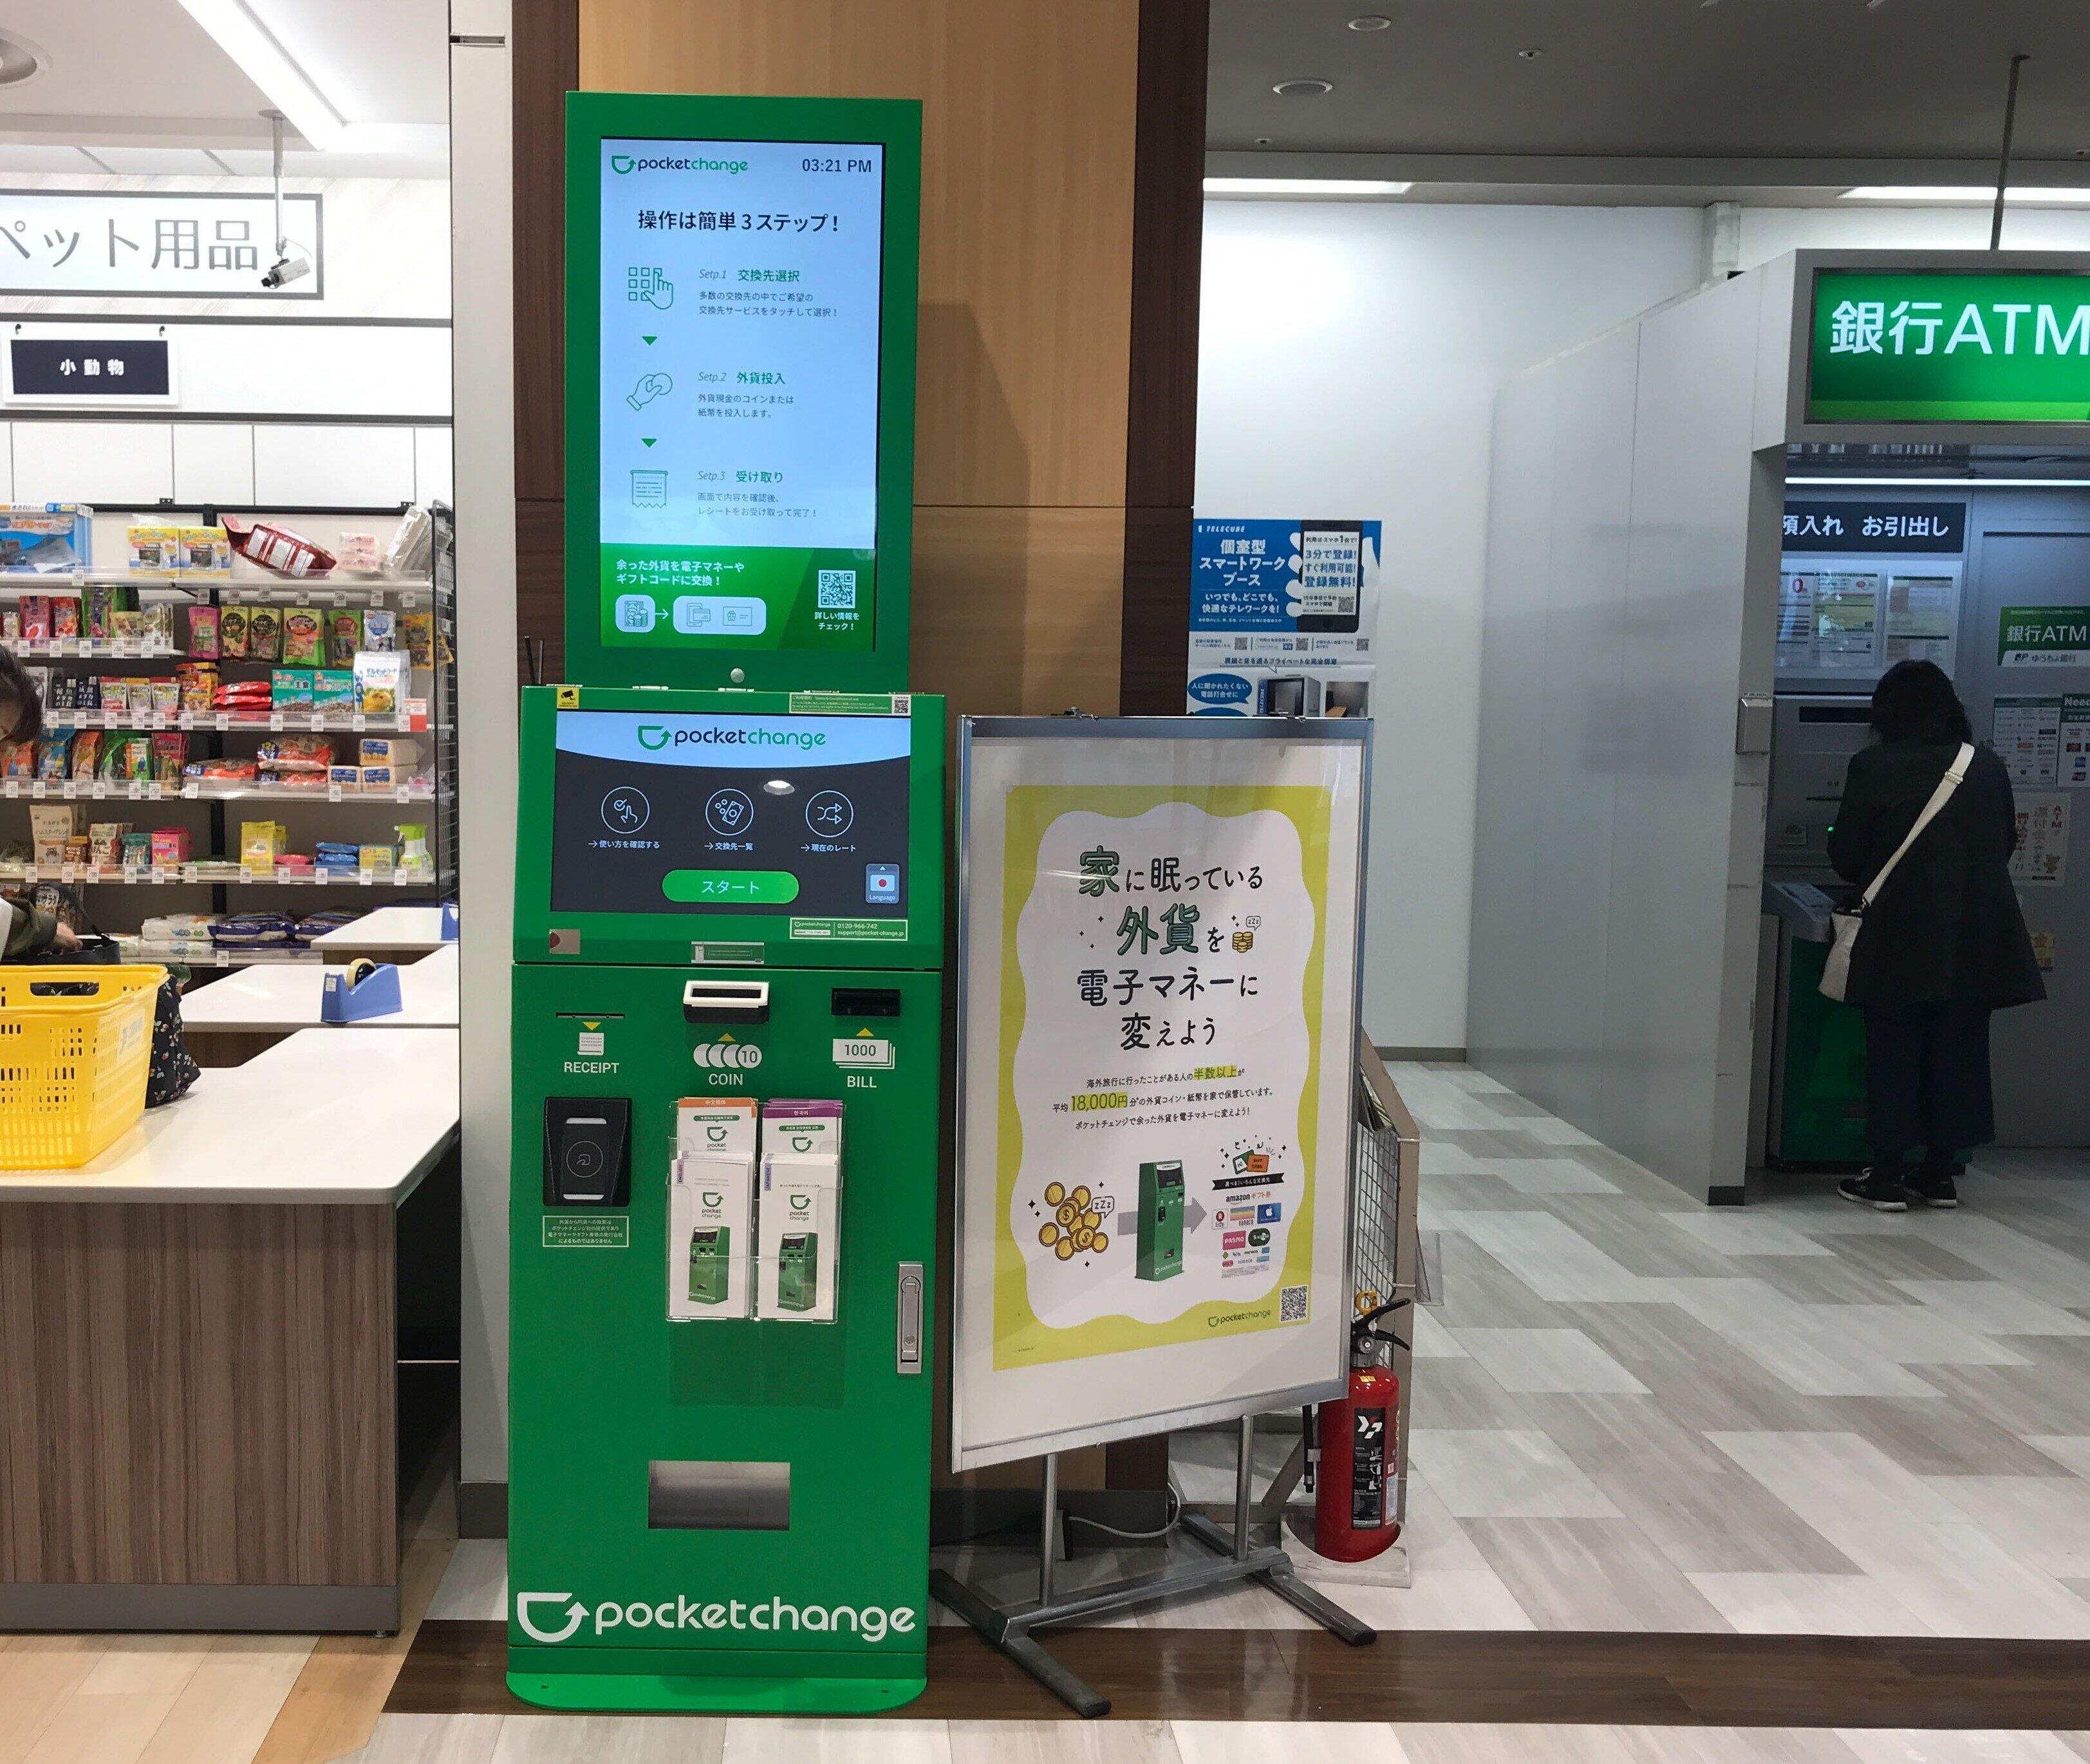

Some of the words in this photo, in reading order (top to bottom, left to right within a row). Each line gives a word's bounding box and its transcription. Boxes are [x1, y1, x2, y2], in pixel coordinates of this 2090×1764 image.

[638, 156, 749, 174] pocketchange
[802, 159, 842, 172] 03:21
[848, 160, 872, 173] PM
[638, 210, 838, 232] 操作は簡単3ステップ！
[699, 269, 727, 281] Setp.1
[738, 270, 799, 282] 交換先選択
[699, 292, 813, 302] 多数の交換先の中でご希望の
[1830, 301, 2090, 355] 銀行ATM
[60, 358, 124, 376] 小動物
[698, 372, 727, 383] Setp.2
[737, 372, 786, 384] 外貨投入
[698, 394, 794, 404] 外貨現金のコインまたは
[698, 408, 772, 418] 紙幣を投入します。
[698, 471, 725, 481] Setp.3
[736, 471, 783, 483] 受け取り
[698, 492, 779, 503] 画面で内容を確認後、
[1862, 516, 1950, 537] お引出し
[1220, 539, 1266, 555] 個室型
[617, 560, 745, 573] 余った外貨を電子マネーや
[1199, 556, 1285, 571] スマートワーク
[617, 575, 721, 586] ギフトコードに交換！
[1223, 571, 1260, 586] ブース
[814, 612, 860, 621] 詳しい情報を
[2007, 625, 2087, 642] 銀行ATM
[675, 727, 826, 750] pocketchange
[599, 840, 660, 850] 使い方を確認する
[714, 842, 753, 851] 交換先一覧
[811, 844, 856, 852] 現在のレート
[1079, 845, 1263, 897] 家に眠っている
[702, 880, 760, 895] スタート
[1117, 903, 1224, 955] 外貨を
[1077, 967, 1258, 1007] 電子マネーに
[1121, 1012, 1216, 1050] 変えよう
[742, 1050, 758, 1064] 10
[844, 1044, 877, 1057] 1000
[564, 1062, 620, 1073] RECEIPT
[709, 1073, 743, 1086] COIN
[847, 1076, 877, 1088] BILL
[1226, 1194, 1250, 1202] amazon
[1220, 1310, 1271, 1325] pocketchange
[596, 1595, 915, 1642] pocketchange
